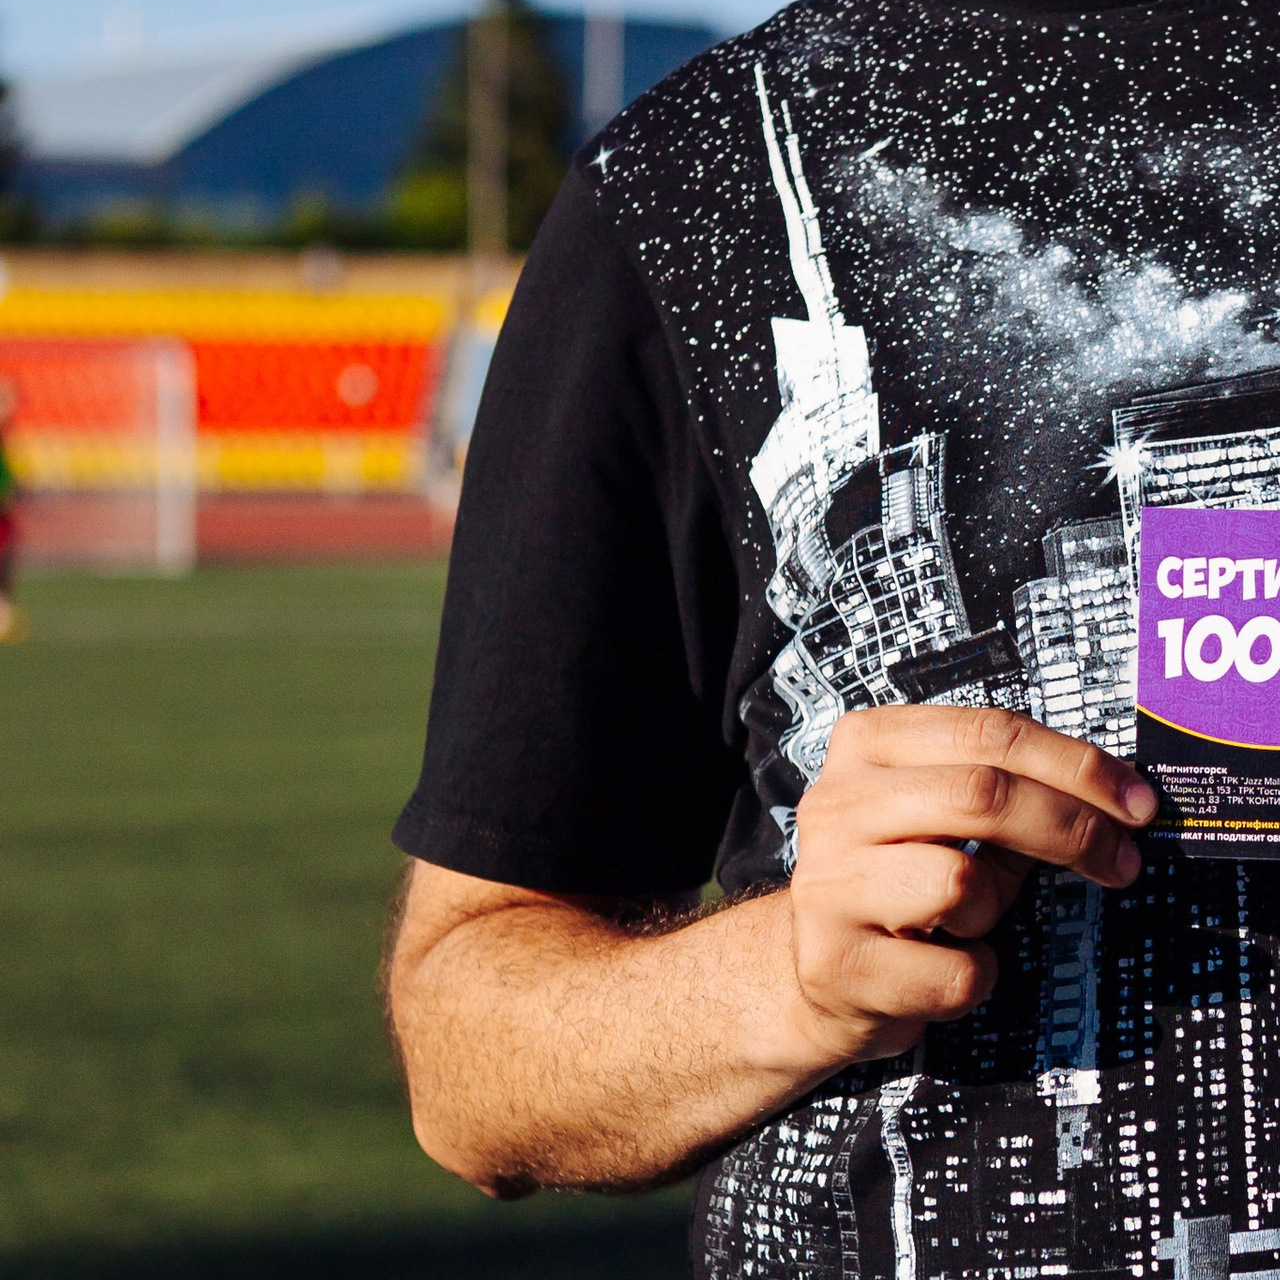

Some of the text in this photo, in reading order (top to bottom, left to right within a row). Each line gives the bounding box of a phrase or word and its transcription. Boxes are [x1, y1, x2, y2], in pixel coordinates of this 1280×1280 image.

[1147, 764, 1228, 775] г. Магнитогорск
[1162, 775, 1199, 785] Герцена,
[1222, 777, 1239, 785] ТРК
[1241, 777, 1262, 786] "Jazz
[1216, 787, 1231, 795] 153
[1238, 787, 1255, 795] ТРК
[1208, 796, 1220, 804] 83
[1227, 797, 1244, 805] ТРК
[1147, 831, 1203, 840] СЕРТИФИКАТ
[1204, 832, 1216, 841] НЕ
[1217, 833, 1265, 842] ПОДЛЕЖИТ
